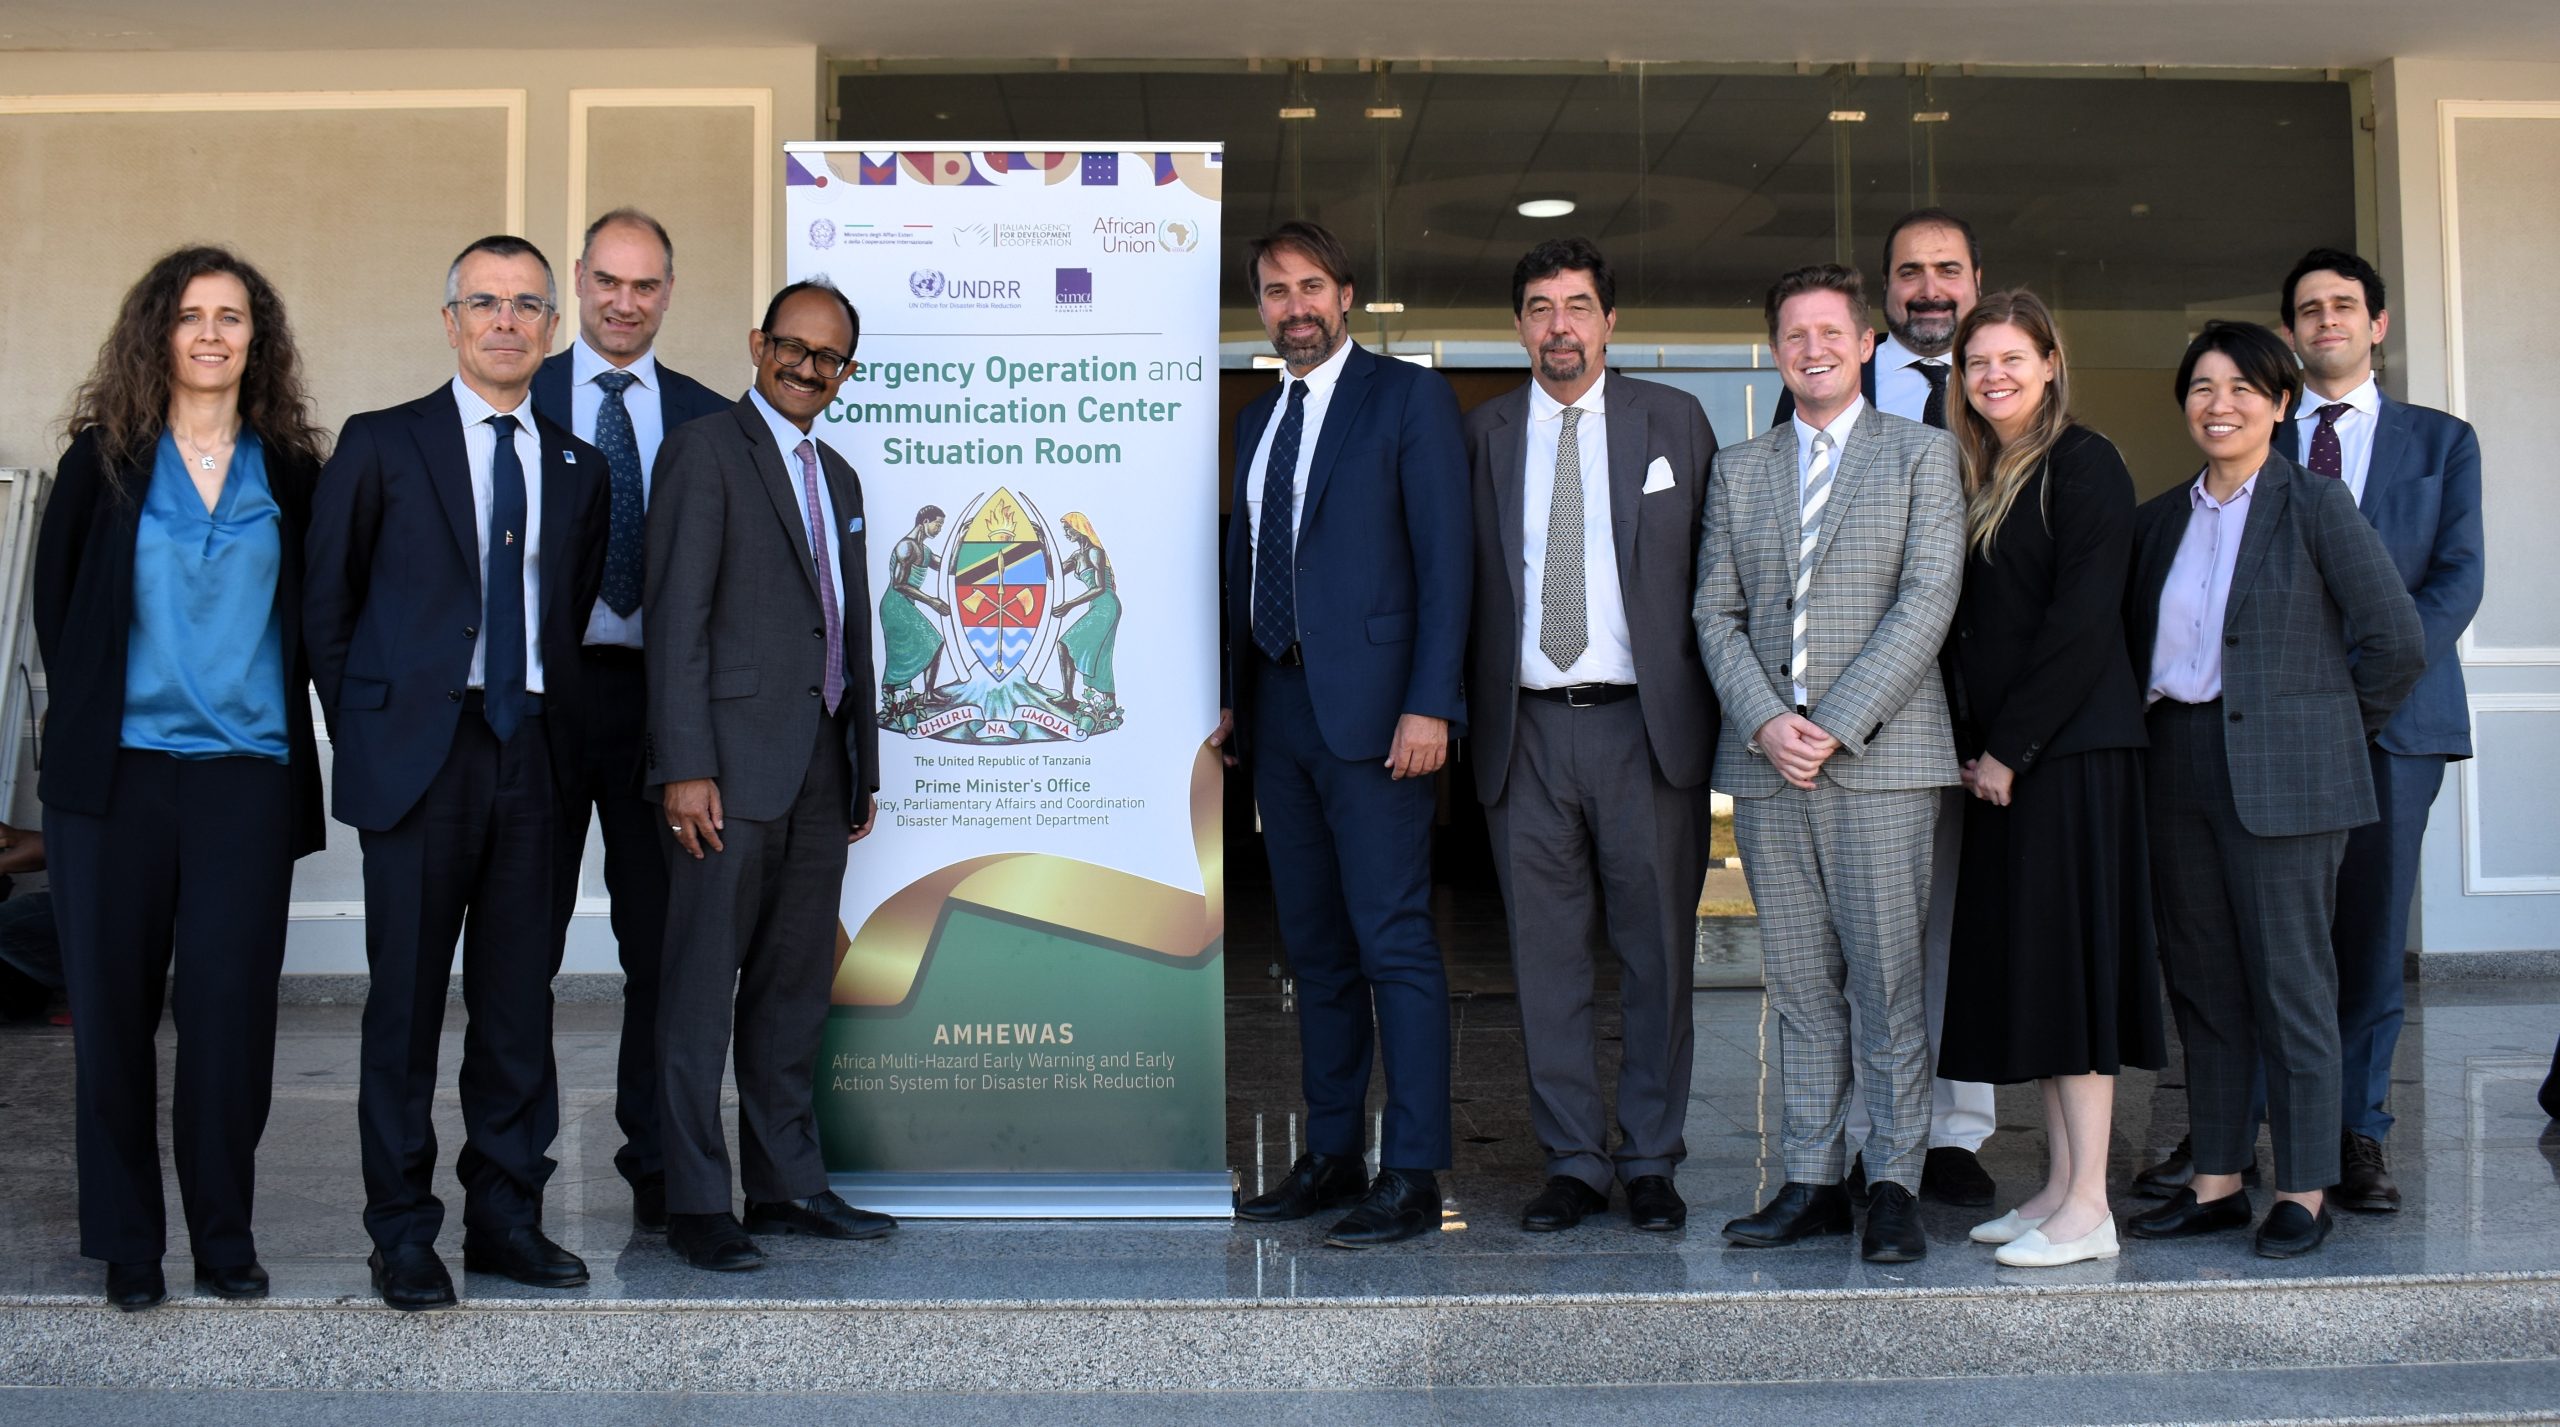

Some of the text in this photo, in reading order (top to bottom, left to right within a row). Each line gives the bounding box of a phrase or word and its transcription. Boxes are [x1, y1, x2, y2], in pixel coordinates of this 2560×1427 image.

[1093, 217, 1155, 234] African
[1000, 239, 1072, 247] COOPERATION
[1103, 235, 1155, 253] Union
[948, 280, 1021, 299] UNDRR
[846, 355, 1202, 390] ergency Operation and
[824, 396, 1182, 424] Communication Center
[883, 437, 1121, 465] Situation Room
[919, 708, 972, 736] UHURU
[987, 723, 1006, 735] NA
[1021, 708, 1070, 735] UMOJA
[914, 756, 1091, 769] The United Republic of Tanzania
[915, 779, 1091, 793] Prime Minister's Office
[876, 797, 1145, 813] licy, Parliamentary Affairs and Coordination
[896, 814, 1110, 828] Disaster Management Department
[933, 1023, 1074, 1045] AMHEWAS
[832, 1051, 1175, 1072] Africa Multi-Hazard Early Warning and Early
[832, 1073, 1175, 1094] Action System for Disaster Risk Reduction
